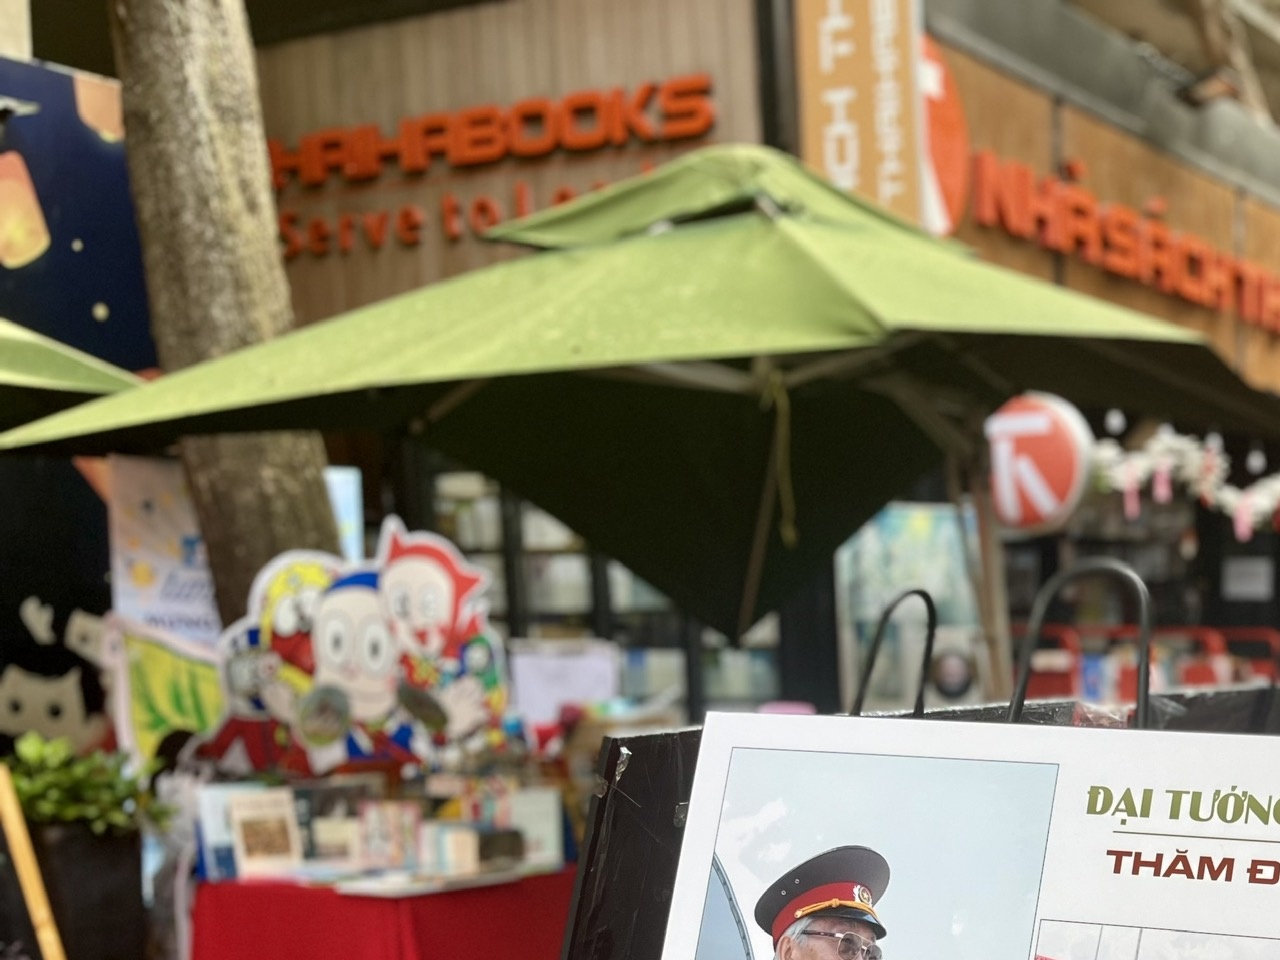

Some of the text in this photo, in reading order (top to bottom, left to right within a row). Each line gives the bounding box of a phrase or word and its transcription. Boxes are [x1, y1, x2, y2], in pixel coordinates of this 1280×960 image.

[279, 207, 425, 259] Serve
[1086, 785, 1154, 826] ĐẠI
[1106, 848, 1236, 882] THĂM
